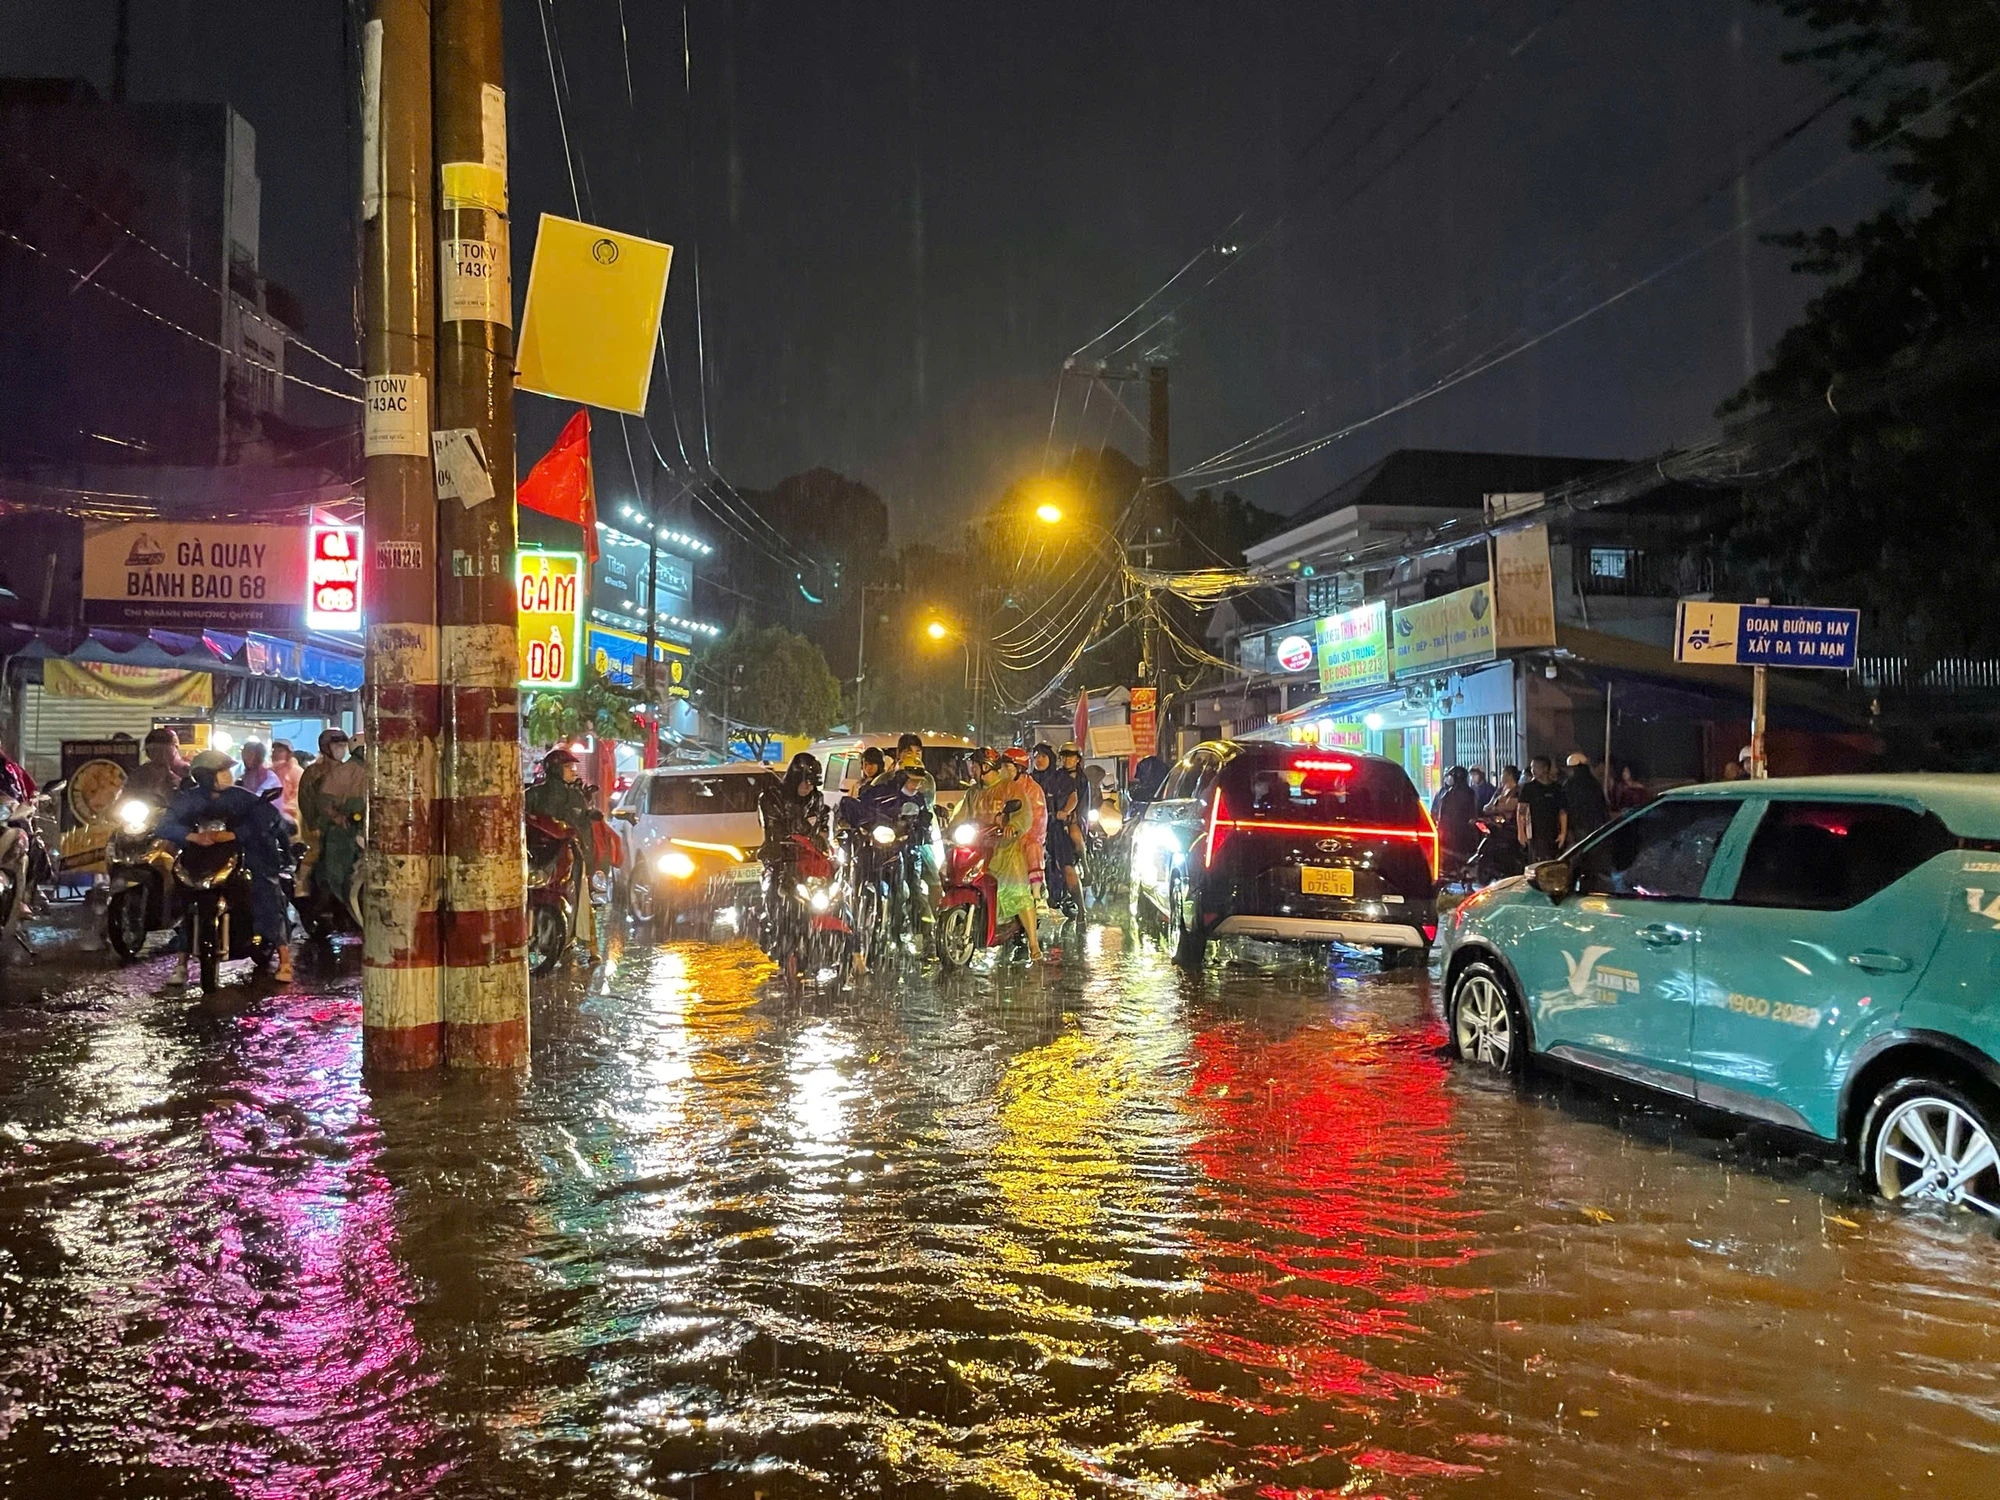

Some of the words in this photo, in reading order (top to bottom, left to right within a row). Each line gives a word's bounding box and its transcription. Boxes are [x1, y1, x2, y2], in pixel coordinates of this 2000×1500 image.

[374, 379, 407, 394] TONV
[368, 397, 407, 413] T43AC
[177, 537, 205, 567] GÀ
[211, 542, 266, 569] QUAY
[127, 567, 185, 597] BÁNH
[191, 574, 232, 599] BAO
[239, 575, 266, 600] 68
[521, 557, 577, 613] CẦM
[1746, 618, 1779, 636] ĐOẠN
[1782, 616, 1822, 635] ĐƯỜNG
[1826, 621, 1850, 636] HAY
[1775, 640, 1792, 655] RA
[1797, 641, 1816, 656] TAI
[1819, 641, 1845, 660] NẠN
[1308, 881, 1347, 894] 076.16
